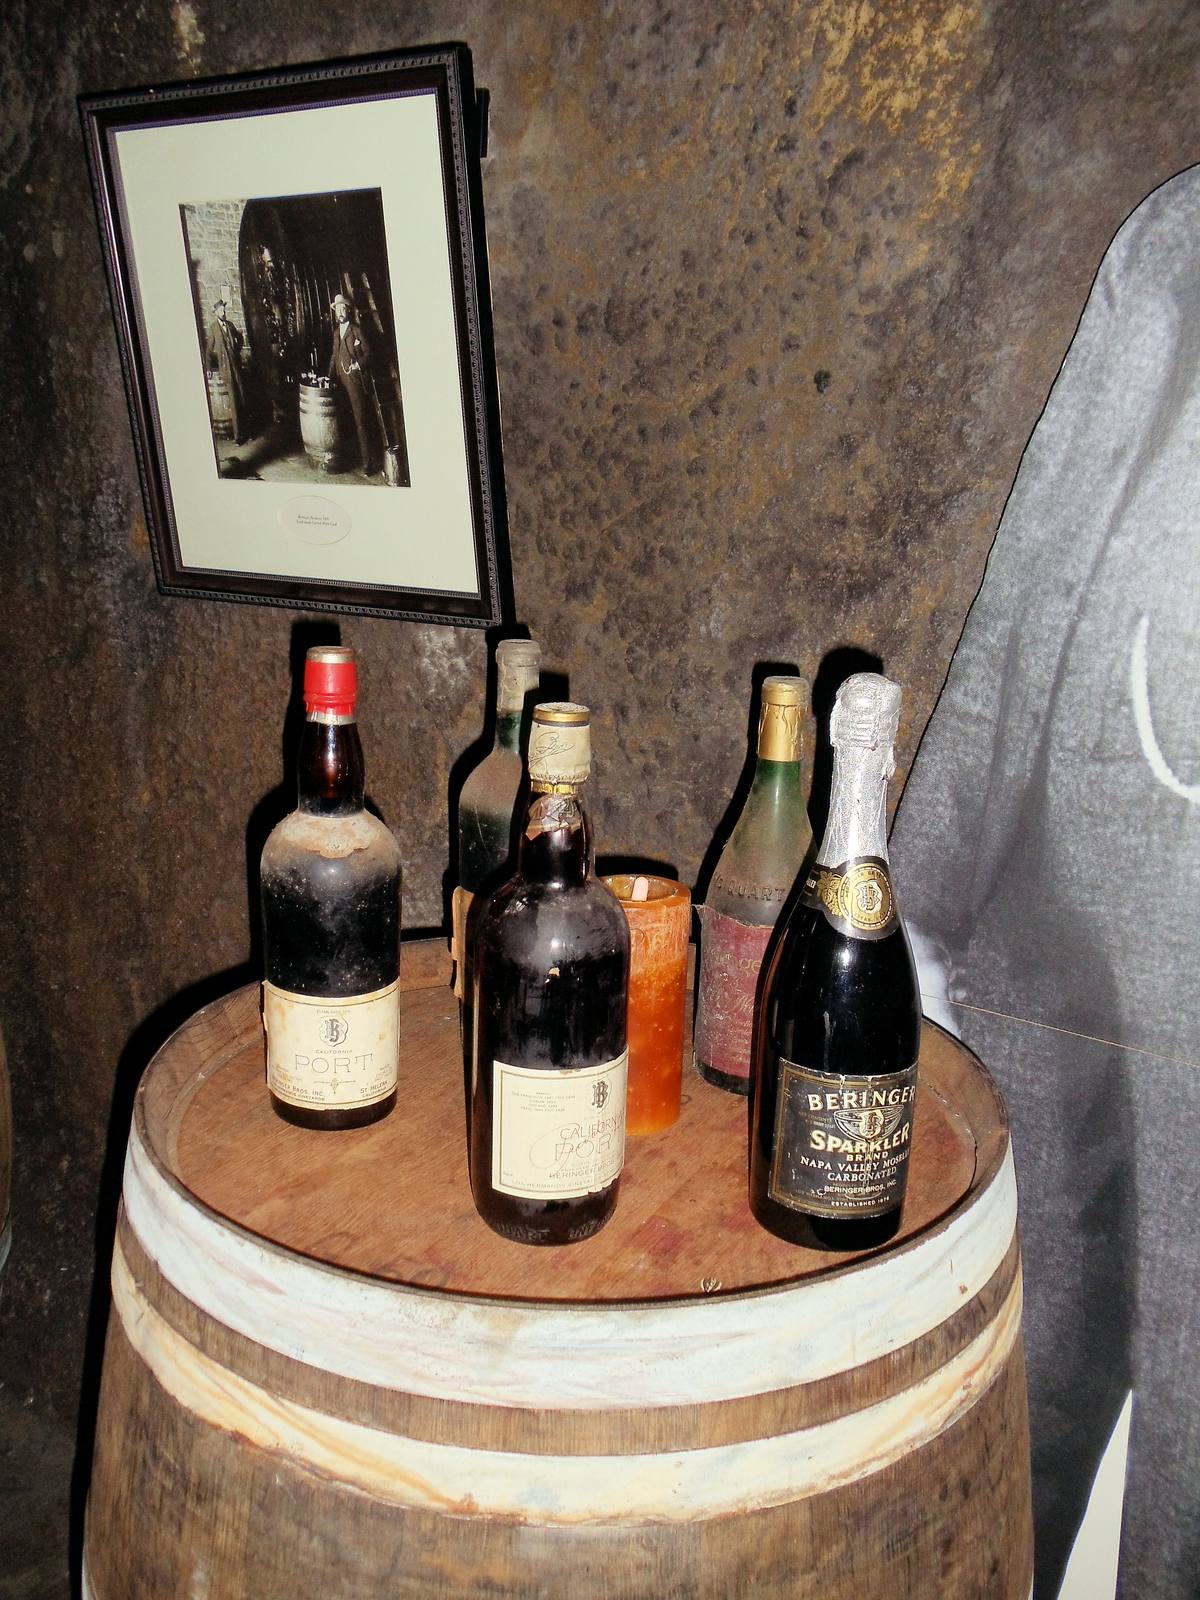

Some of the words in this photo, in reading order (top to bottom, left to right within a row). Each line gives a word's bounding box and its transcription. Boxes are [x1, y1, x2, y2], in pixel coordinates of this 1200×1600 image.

[295, 1053, 374, 1074] PORT
[807, 1085, 916, 1111] BERINGER
[810, 1122, 910, 1153] SPARKLER
[800, 1156, 832, 1170] NAPA
[838, 1161, 880, 1172] VALLEY
[846, 1151, 889, 1162] BRAND
[827, 1166, 897, 1182] CARBONATED
[824, 1185, 864, 1194] BERINGER
[865, 1183, 886, 1193] BROS.
